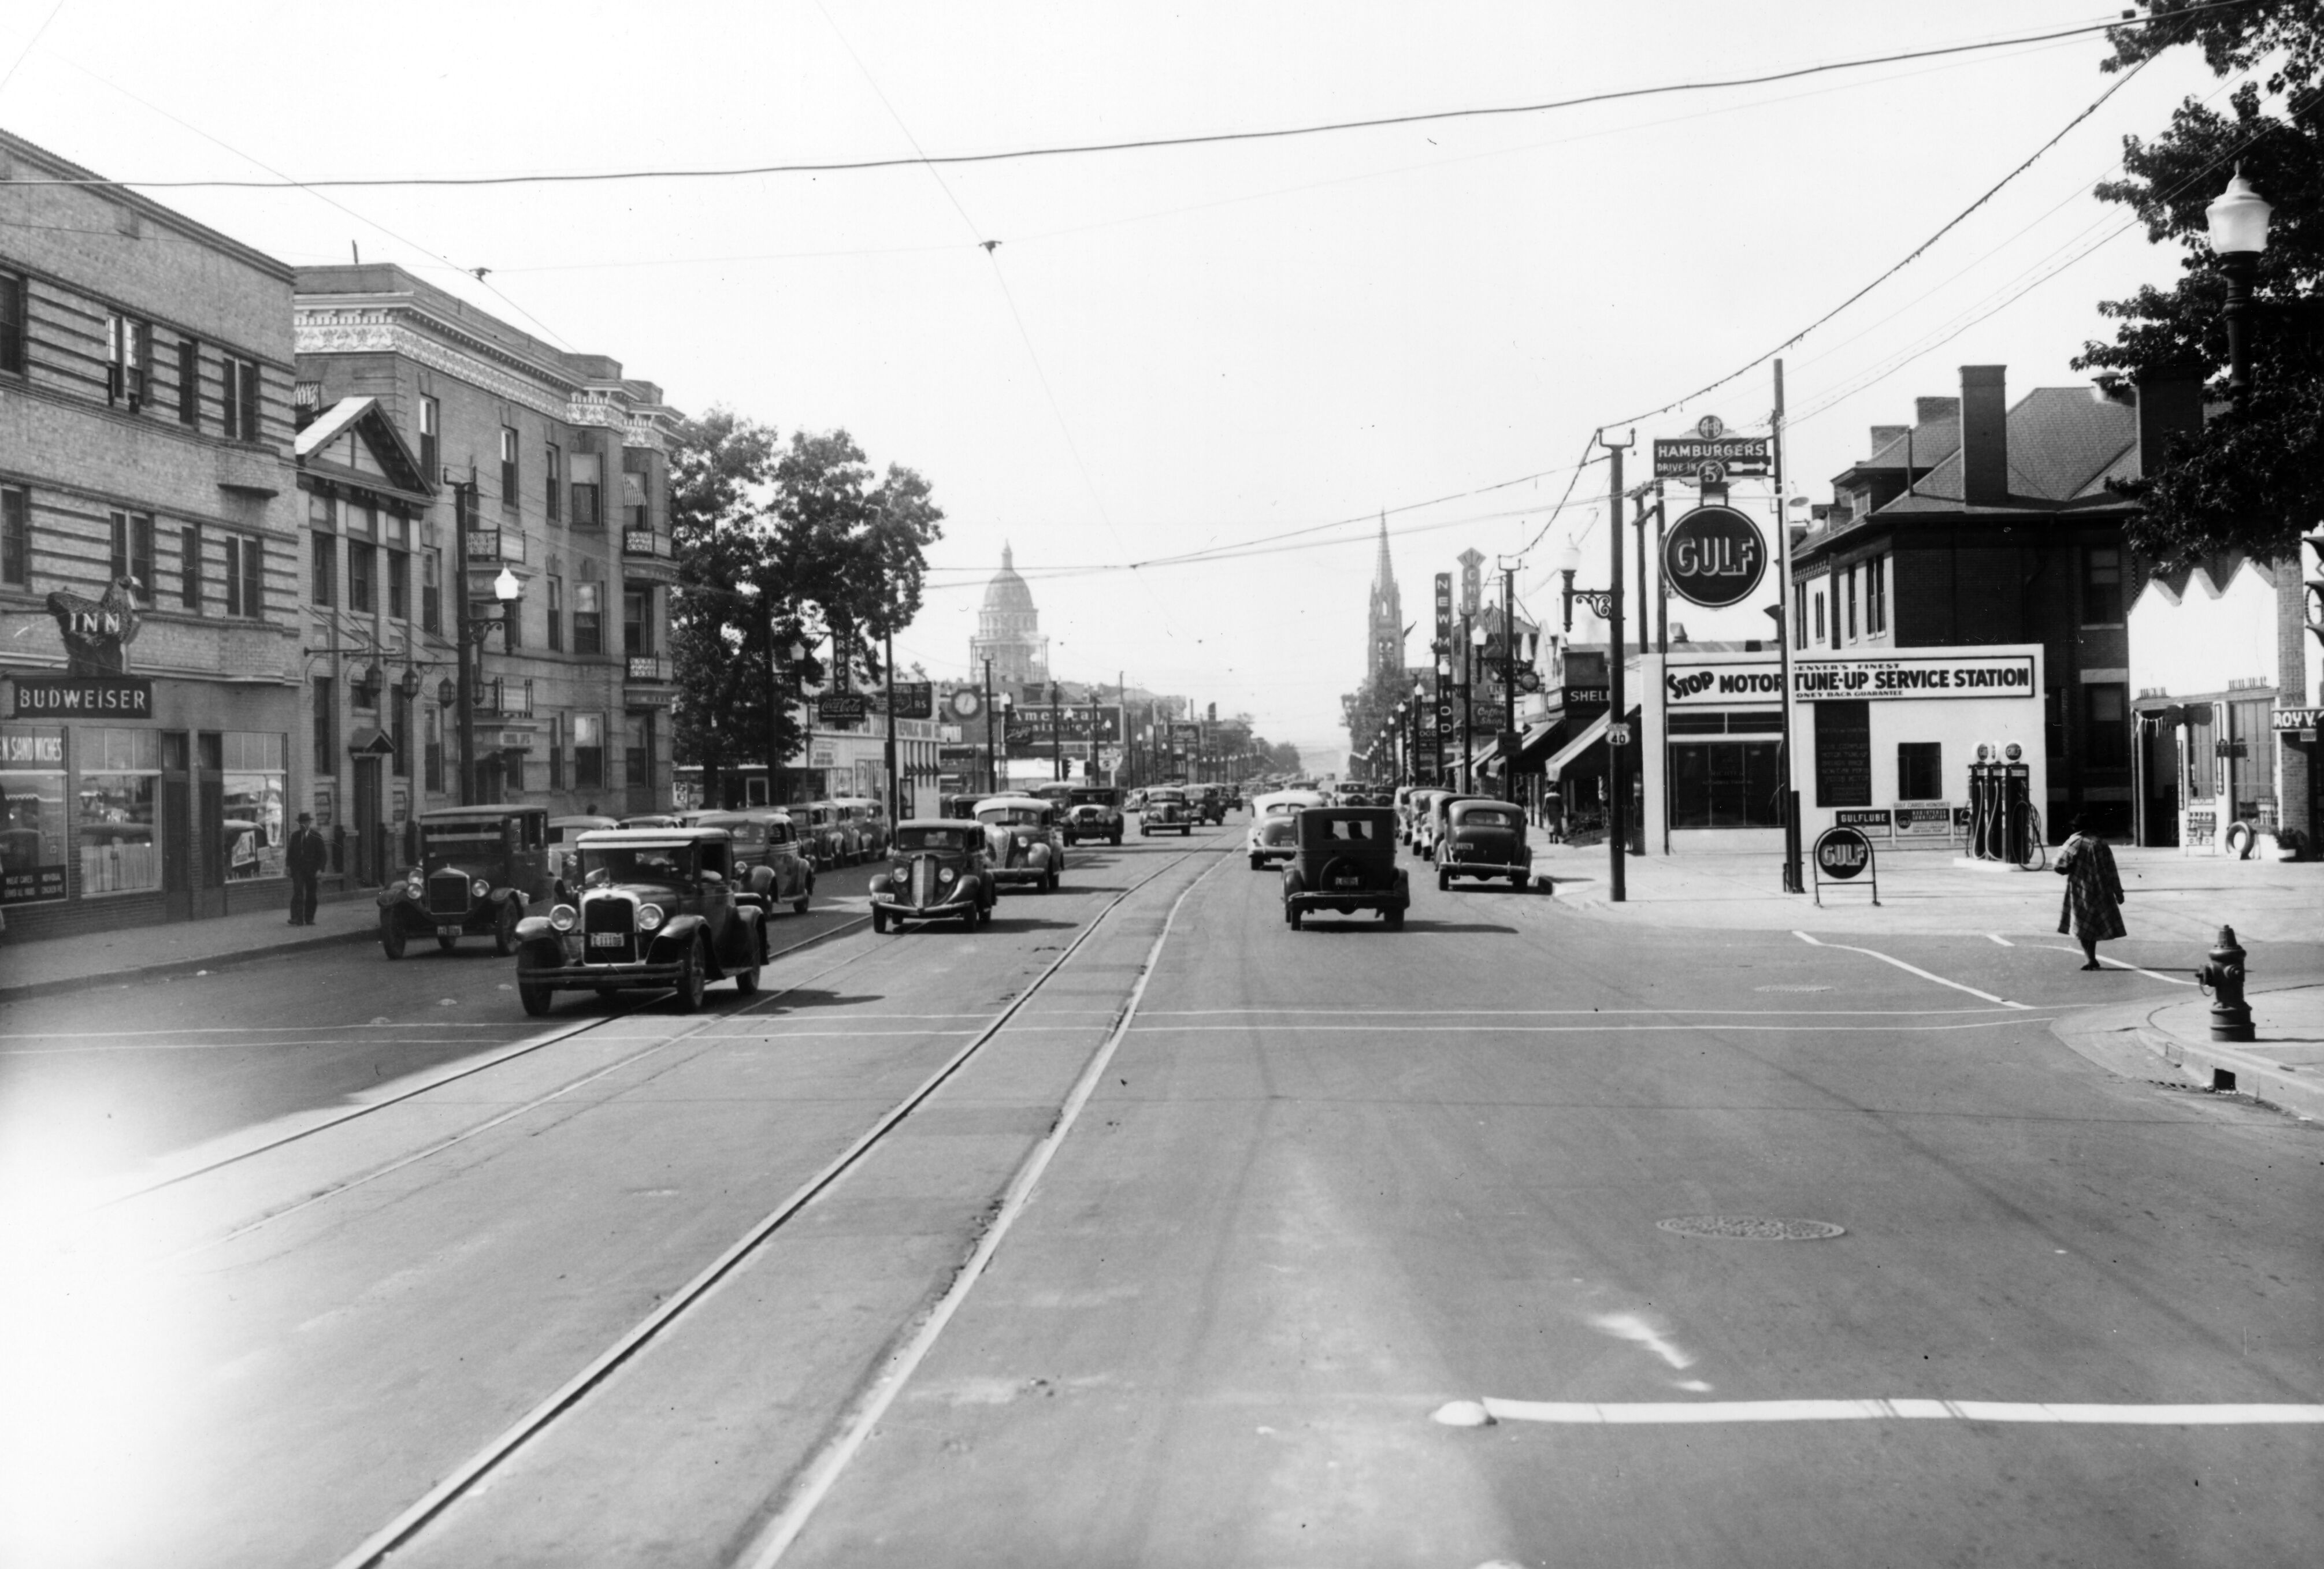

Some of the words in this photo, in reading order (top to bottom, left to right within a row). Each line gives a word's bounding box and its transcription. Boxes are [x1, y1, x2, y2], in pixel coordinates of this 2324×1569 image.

[1658, 444, 1764, 458] HAMBURGERS
[1657, 463, 1684, 472] DRIVE
[1673, 537, 1754, 577] GULF
[70, 613, 119, 633] INN
[1438, 637, 1451, 733] MEHOD
[1667, 671, 1714, 700] STOP
[1719, 674, 1782, 693] MOTOR
[1794, 671, 1869, 691] TUNE-UP
[1874, 670, 1950, 689] SERVICE
[1954, 668, 2029, 687] STATION
[20, 689, 145, 709] BUDWEISER
[2273, 711, 2302, 727] ROY
[1612, 734, 1625, 743] 40
[1841, 813, 1887, 823] GULFLUBE
[1821, 844, 1865, 866] GULF
